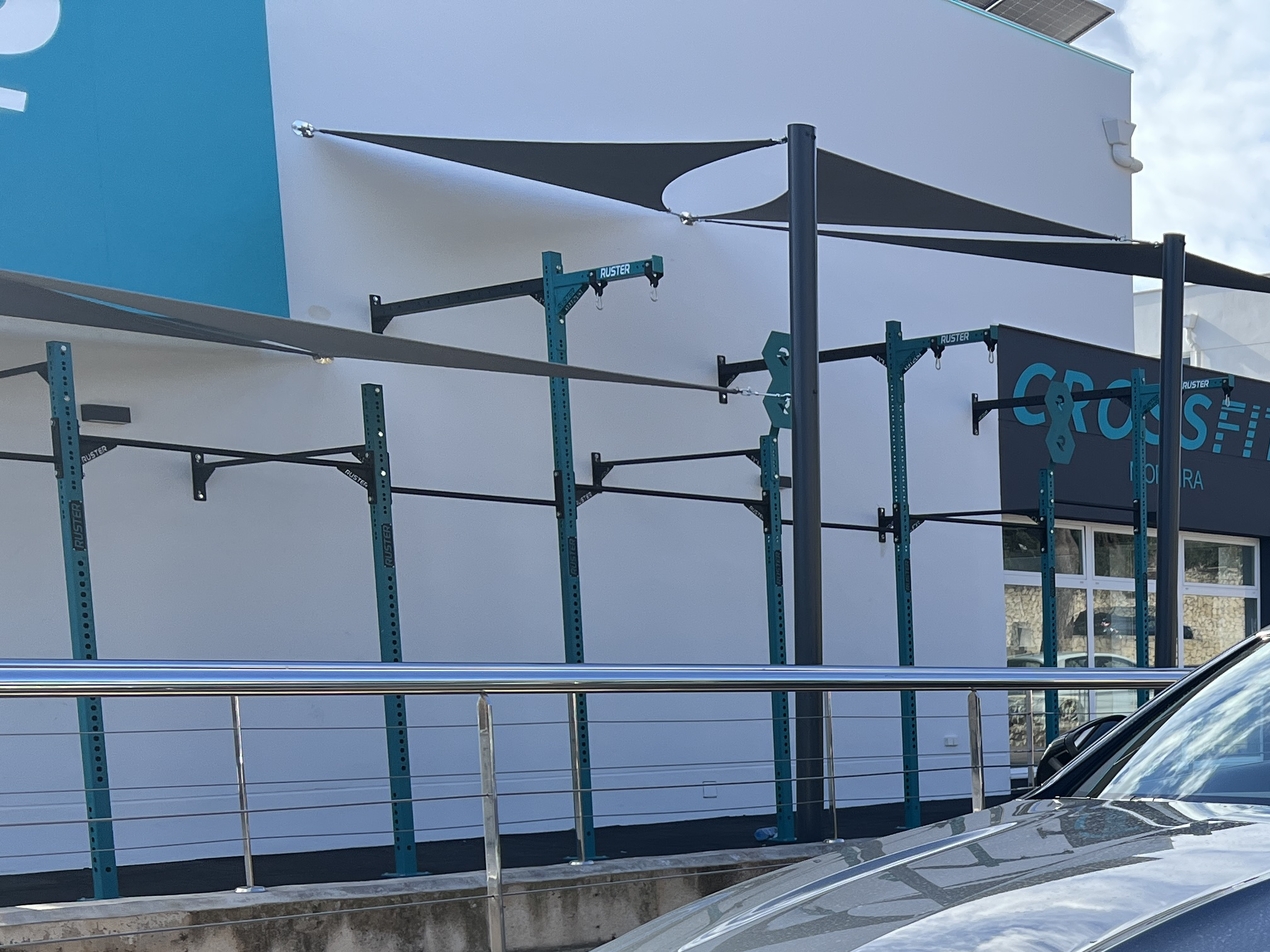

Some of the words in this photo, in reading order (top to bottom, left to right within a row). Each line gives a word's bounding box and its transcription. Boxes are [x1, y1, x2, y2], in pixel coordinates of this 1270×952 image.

[600, 263, 631, 278] RUSTER
[940, 331, 970, 344] RUSTER
[1182, 379, 1210, 390] RUSTER
[80, 445, 108, 464] RUSTER
[344, 468, 369, 489] RUSTER
[71, 502, 85, 549] RUSTER
[382, 524, 395, 568] RUSTER
